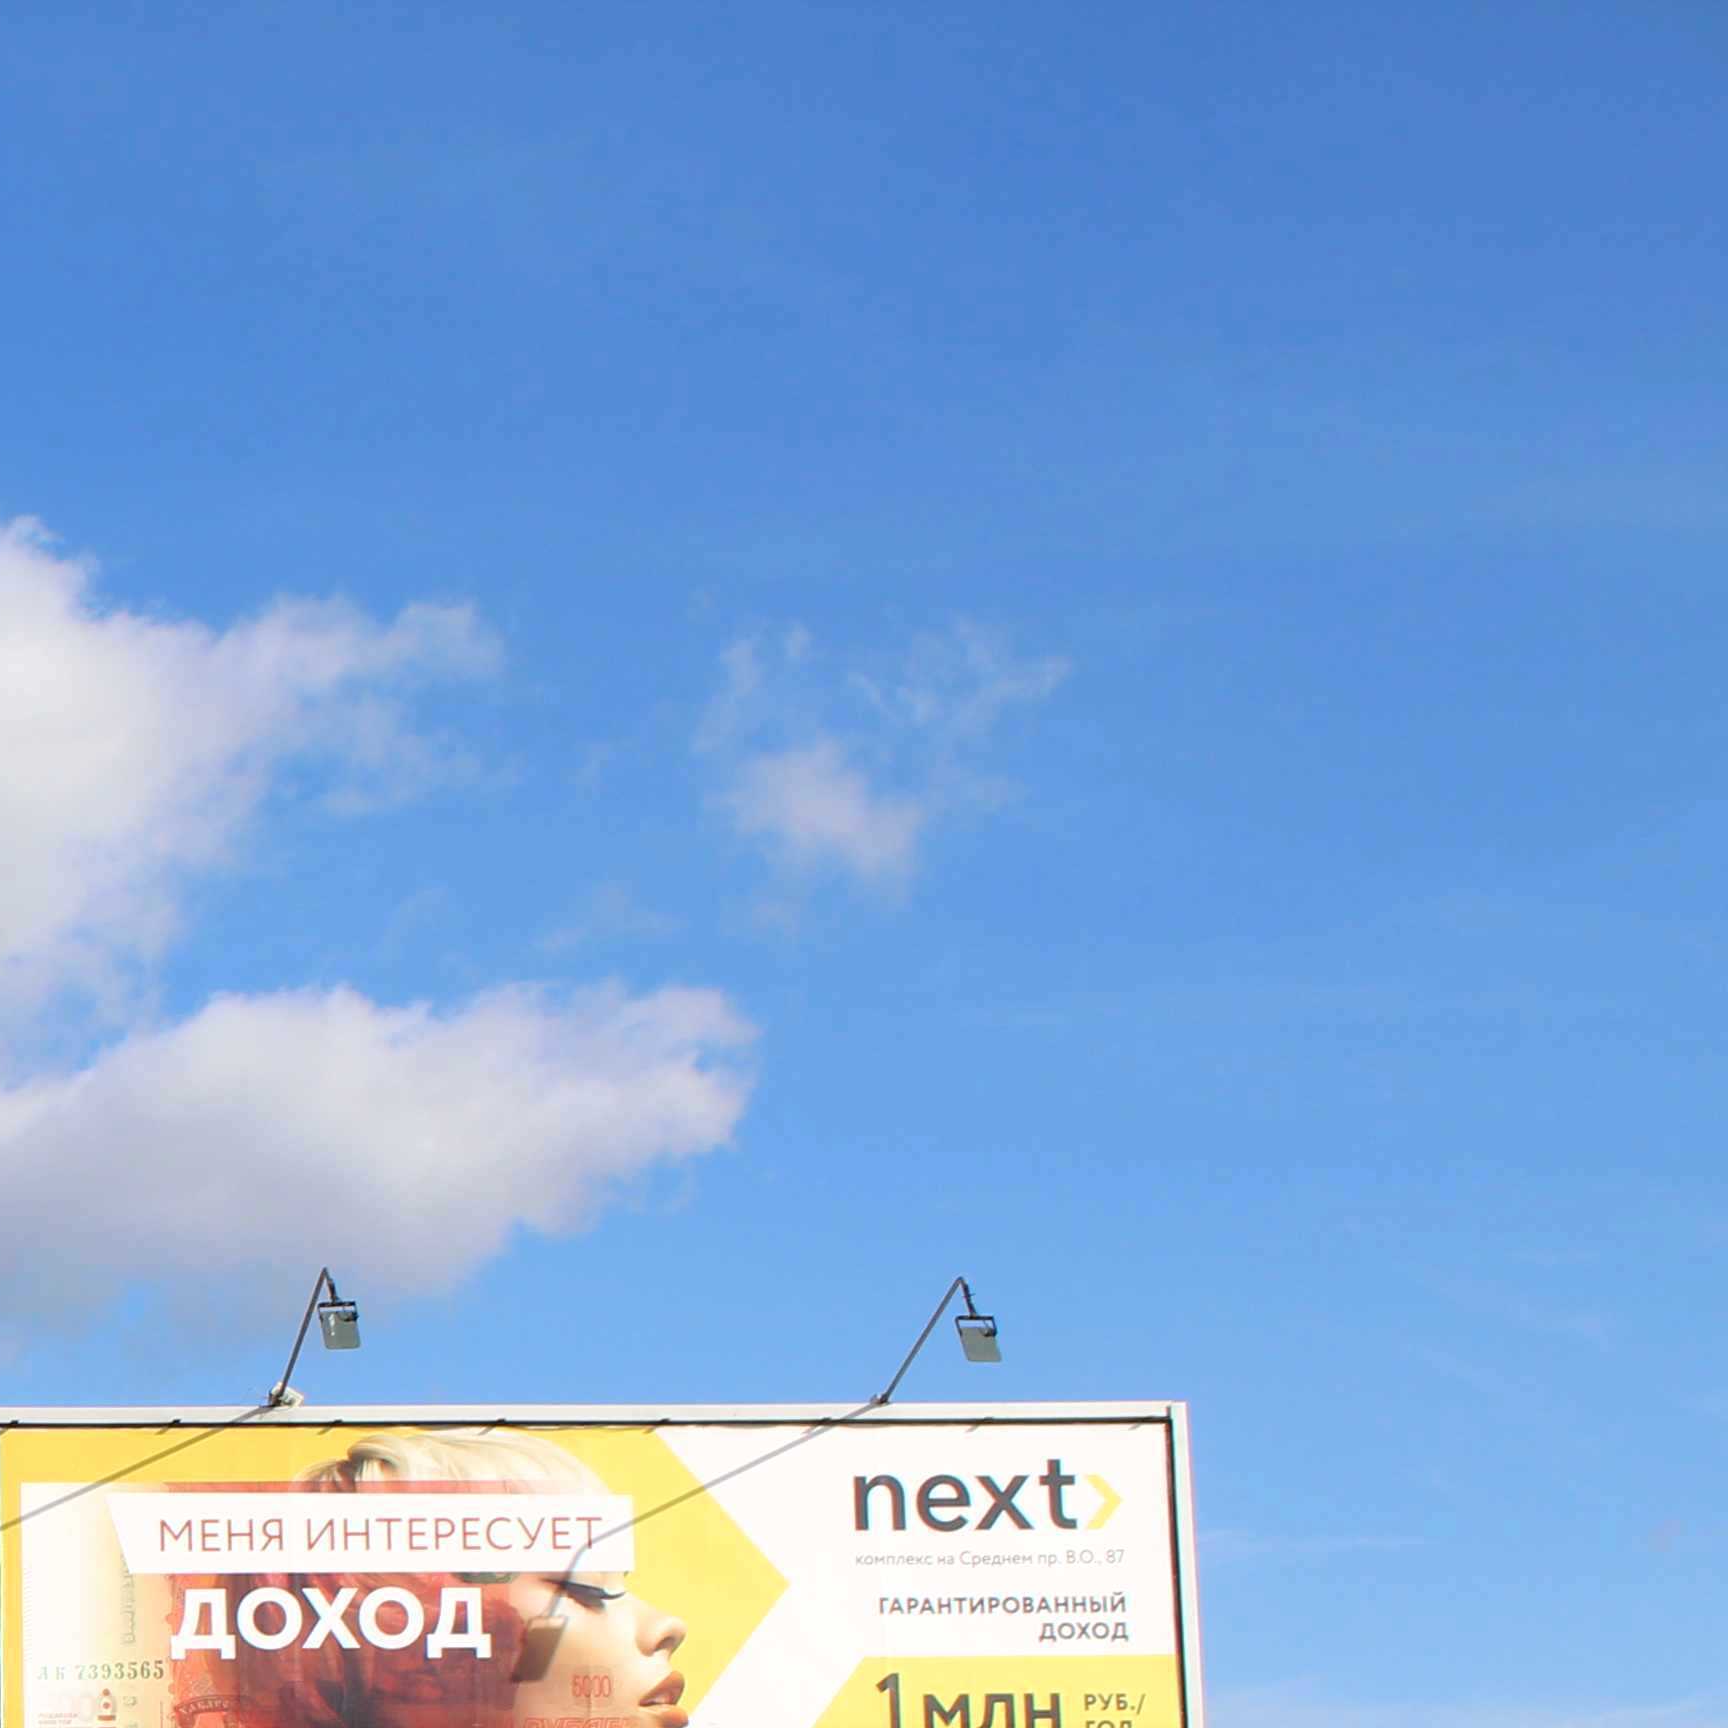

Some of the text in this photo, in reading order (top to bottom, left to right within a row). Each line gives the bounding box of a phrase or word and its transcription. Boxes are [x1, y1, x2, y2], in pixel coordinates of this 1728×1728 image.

[853, 1459, 1078, 1532] next
[159, 1516, 603, 1551] МЕНЯ ИНТЕРЕСУЕТ
[959, 1550, 1033, 1569] Среднем
[878, 1592, 1127, 1616] ГАРАНТИРОВАННЫЙ
[170, 1587, 492, 1661] ДОХОД
[1038, 1621, 1130, 1643] ДОХОД
[1083, 1692, 1146, 1715] РУБ./
